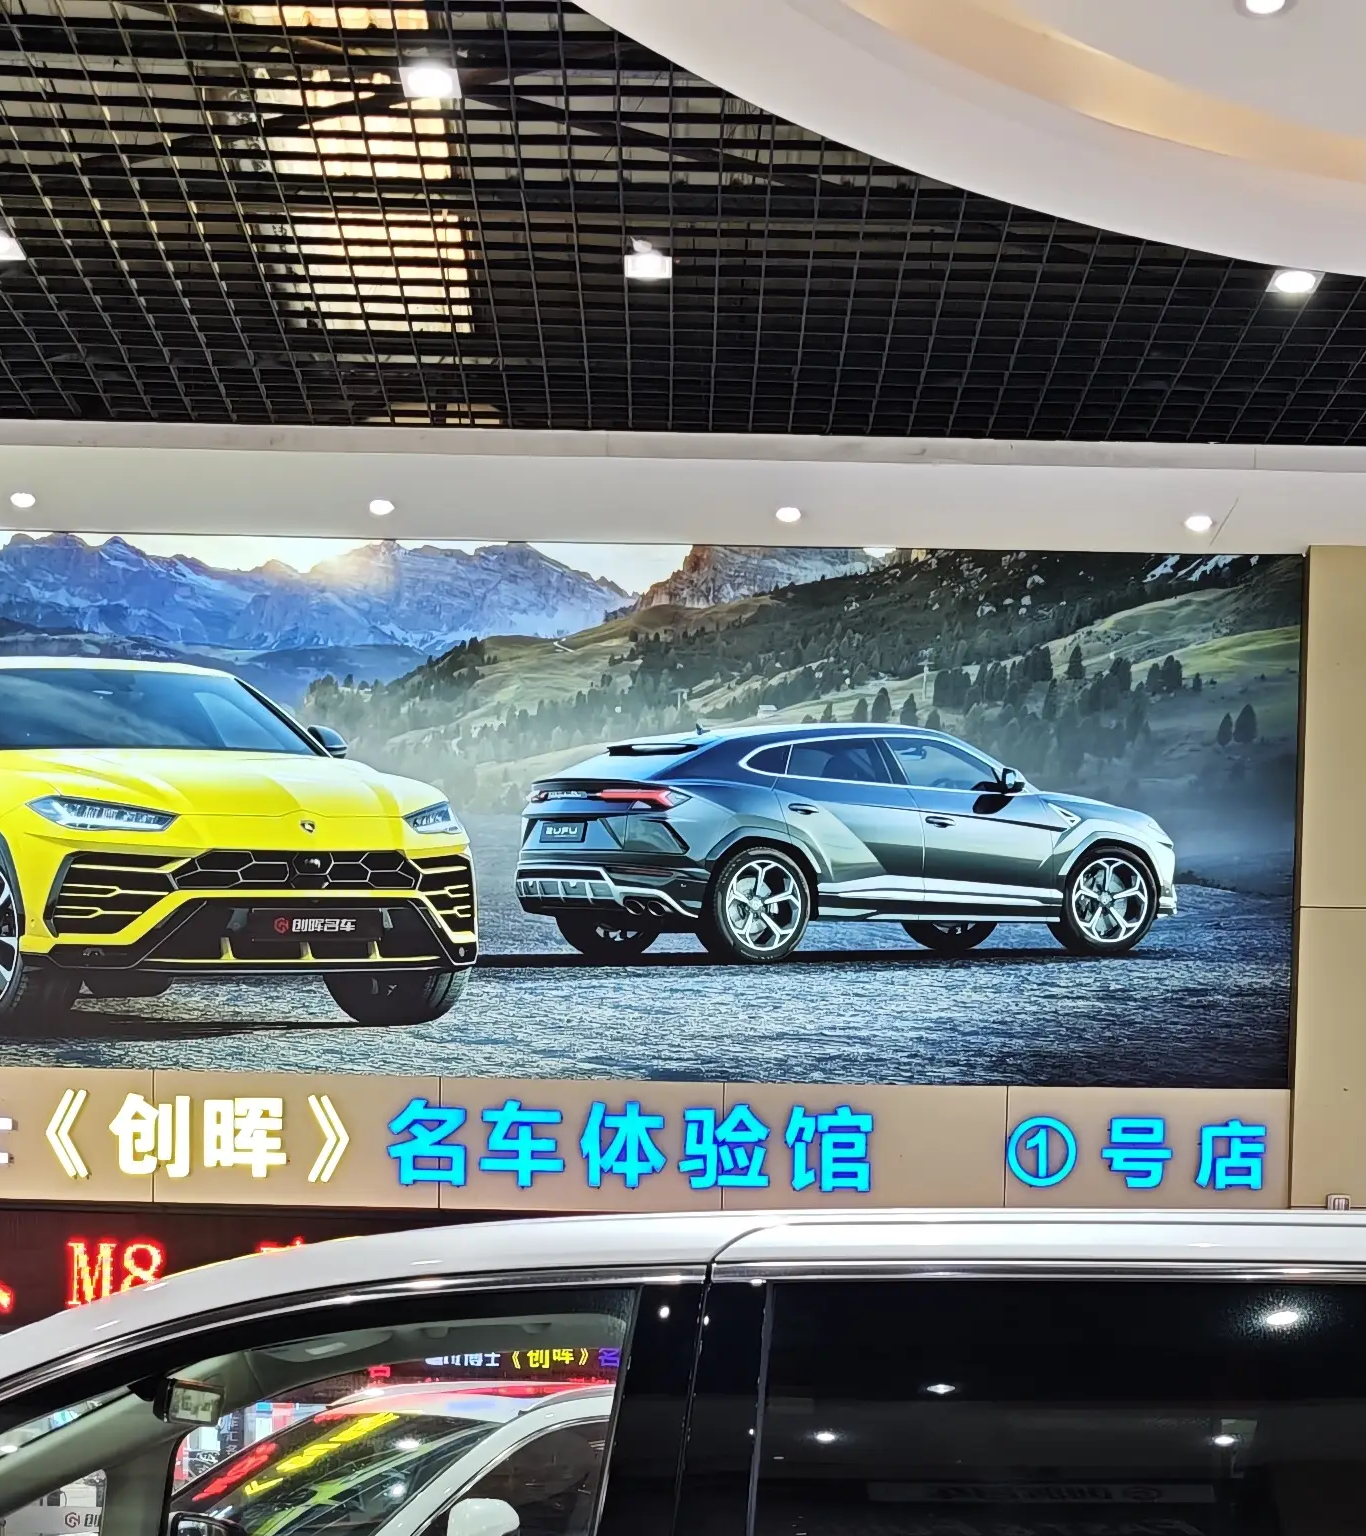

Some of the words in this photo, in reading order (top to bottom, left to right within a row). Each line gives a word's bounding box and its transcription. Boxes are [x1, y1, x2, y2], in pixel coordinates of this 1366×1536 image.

[291, 917, 357, 933] 创晖名车
[45, 1087, 350, 1184] 《创晖》
[387, 1096, 875, 1192] 名车体验馆
[1006, 1114, 1267, 1192] ①号店
